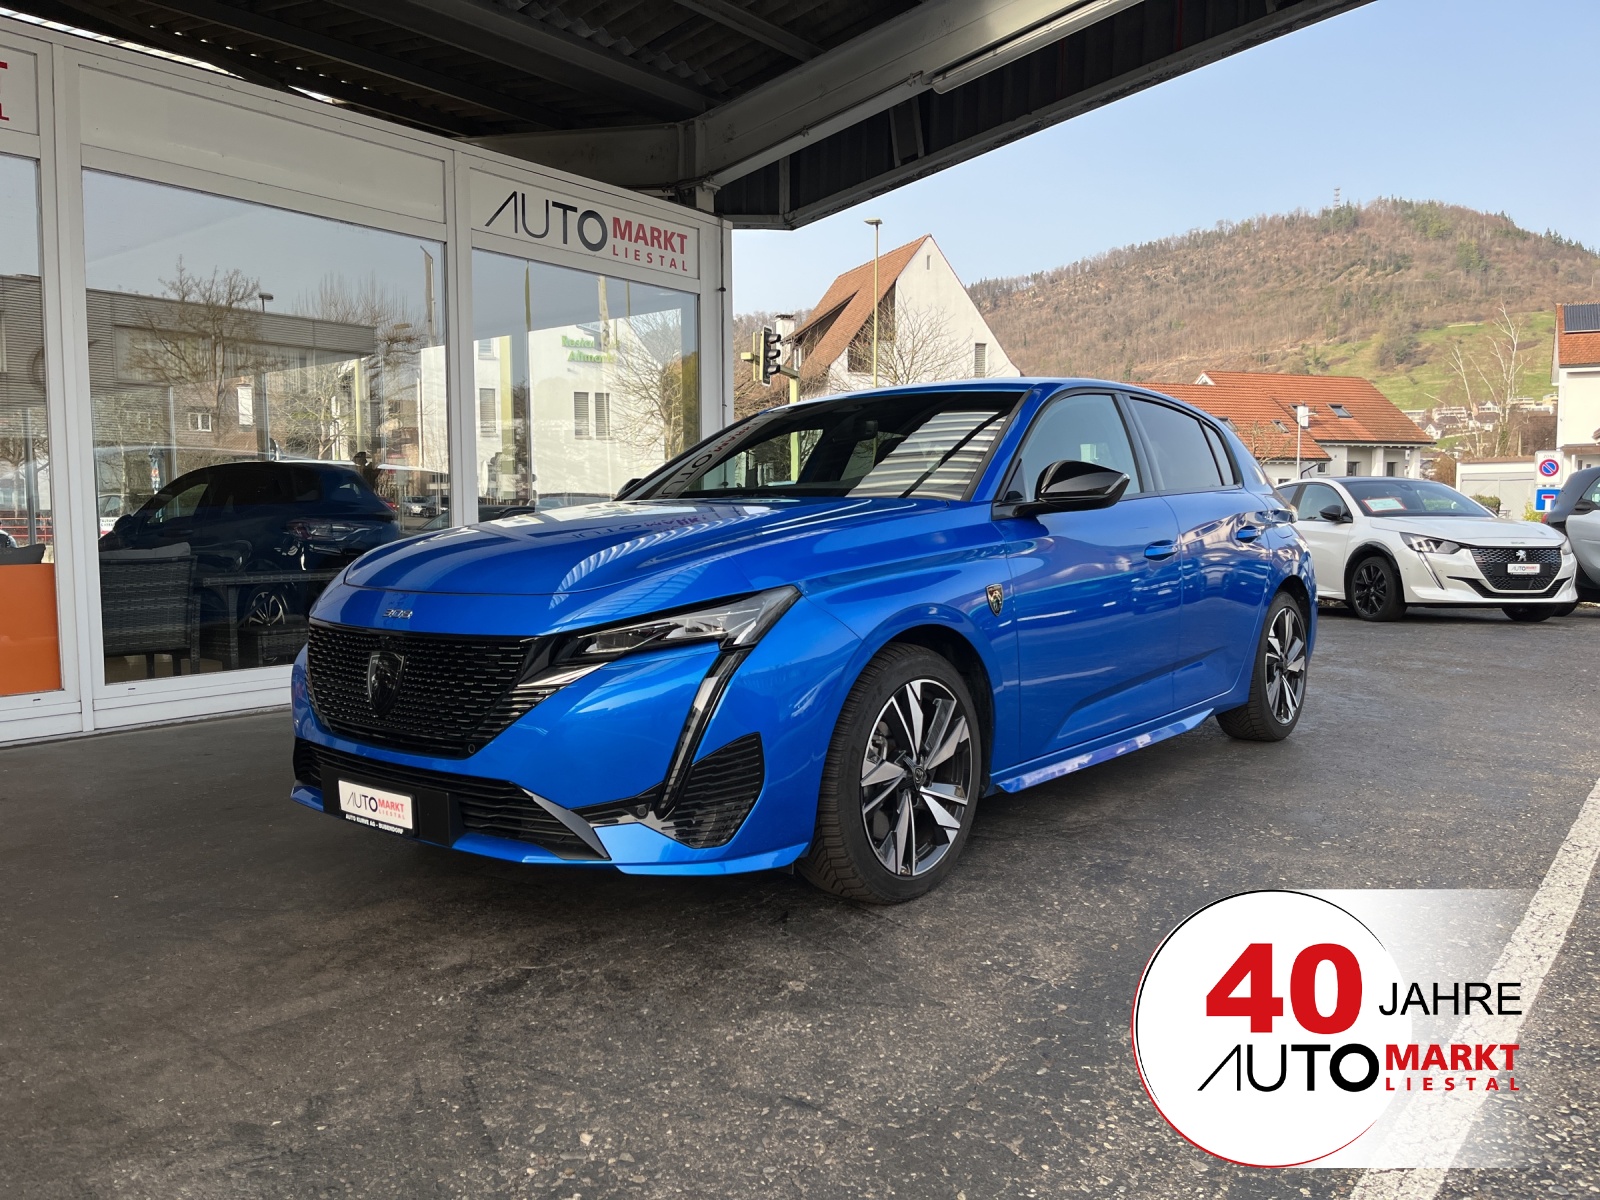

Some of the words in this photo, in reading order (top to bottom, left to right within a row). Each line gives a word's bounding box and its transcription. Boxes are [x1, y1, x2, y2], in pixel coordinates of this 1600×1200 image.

[485, 191, 608, 251] AUTO
[612, 217, 688, 254] MARKT
[612, 244, 688, 271] LIESTAL
[347, 791, 378, 812] AUTO
[378, 798, 404, 813] MARKT
[378, 809, 405, 820] LIESTAL
